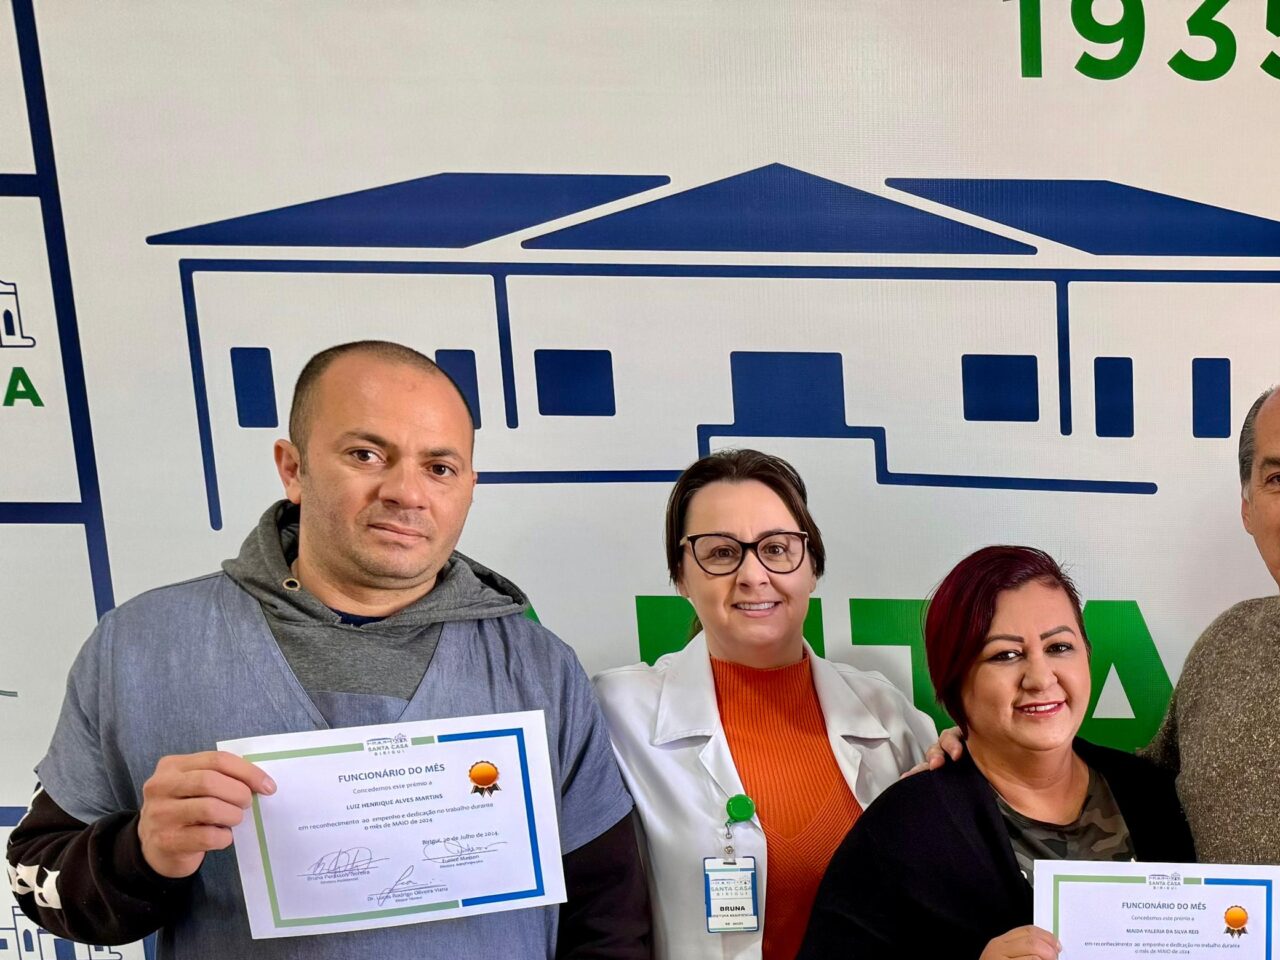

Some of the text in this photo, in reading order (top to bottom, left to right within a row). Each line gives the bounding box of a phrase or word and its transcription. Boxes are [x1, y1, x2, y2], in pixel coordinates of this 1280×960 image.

[338, 763, 446, 783] FUNCIONÁRIO DO MÊS
[352, 784, 392, 794] Concedemos
[362, 799, 394, 808] HENRIQUE
[415, 793, 443, 801] MARTINS
[310, 817, 360, 829] reconhecimento
[372, 813, 400, 822] empenho
[406, 808, 436, 818] dedicação
[446, 804, 470, 812] trabalho
[470, 801, 494, 809] durante
[392, 819, 409, 827] MAIO
[460, 833, 475, 841] Julho
[1122, 901, 1175, 909] FUNCIONÁRIO
[1190, 902, 1206, 910] MÊS
